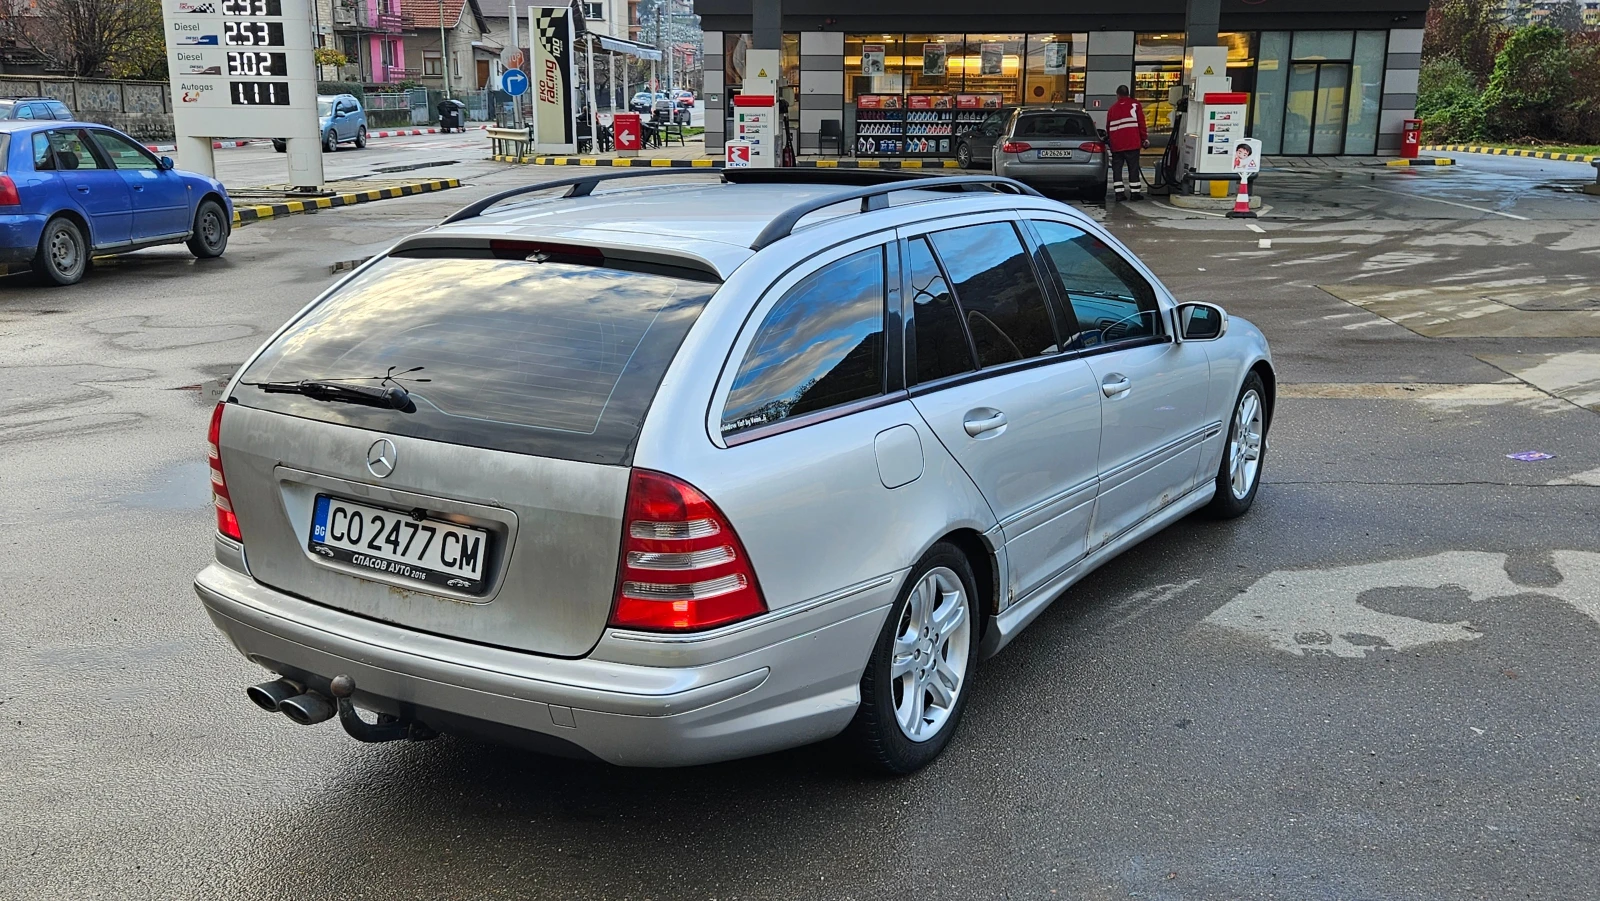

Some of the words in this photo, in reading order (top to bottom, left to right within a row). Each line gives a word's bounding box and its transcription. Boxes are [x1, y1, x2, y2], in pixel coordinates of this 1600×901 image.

[223, 0, 267, 16] 2.93
[174, 23, 200, 31] Diesel
[225, 22, 269, 45] 2.53
[177, 52, 203, 61] Diesel
[552, 38, 561, 57] 100
[229, 52, 271, 75] 3.02
[181, 83, 213, 92] Autogas
[539, 80, 547, 102] EKO
[545, 59, 557, 104] racing
[238, 83, 275, 104] 1.11
[314, 524, 326, 537] BG
[330, 507, 364, 546] CO
[366, 515, 437, 561] 2477
[440, 531, 481, 574] CM
[352, 554, 387, 571] СПАСОВ
[388, 562, 411, 576] АУТО
[411, 569, 426, 580] 2016
